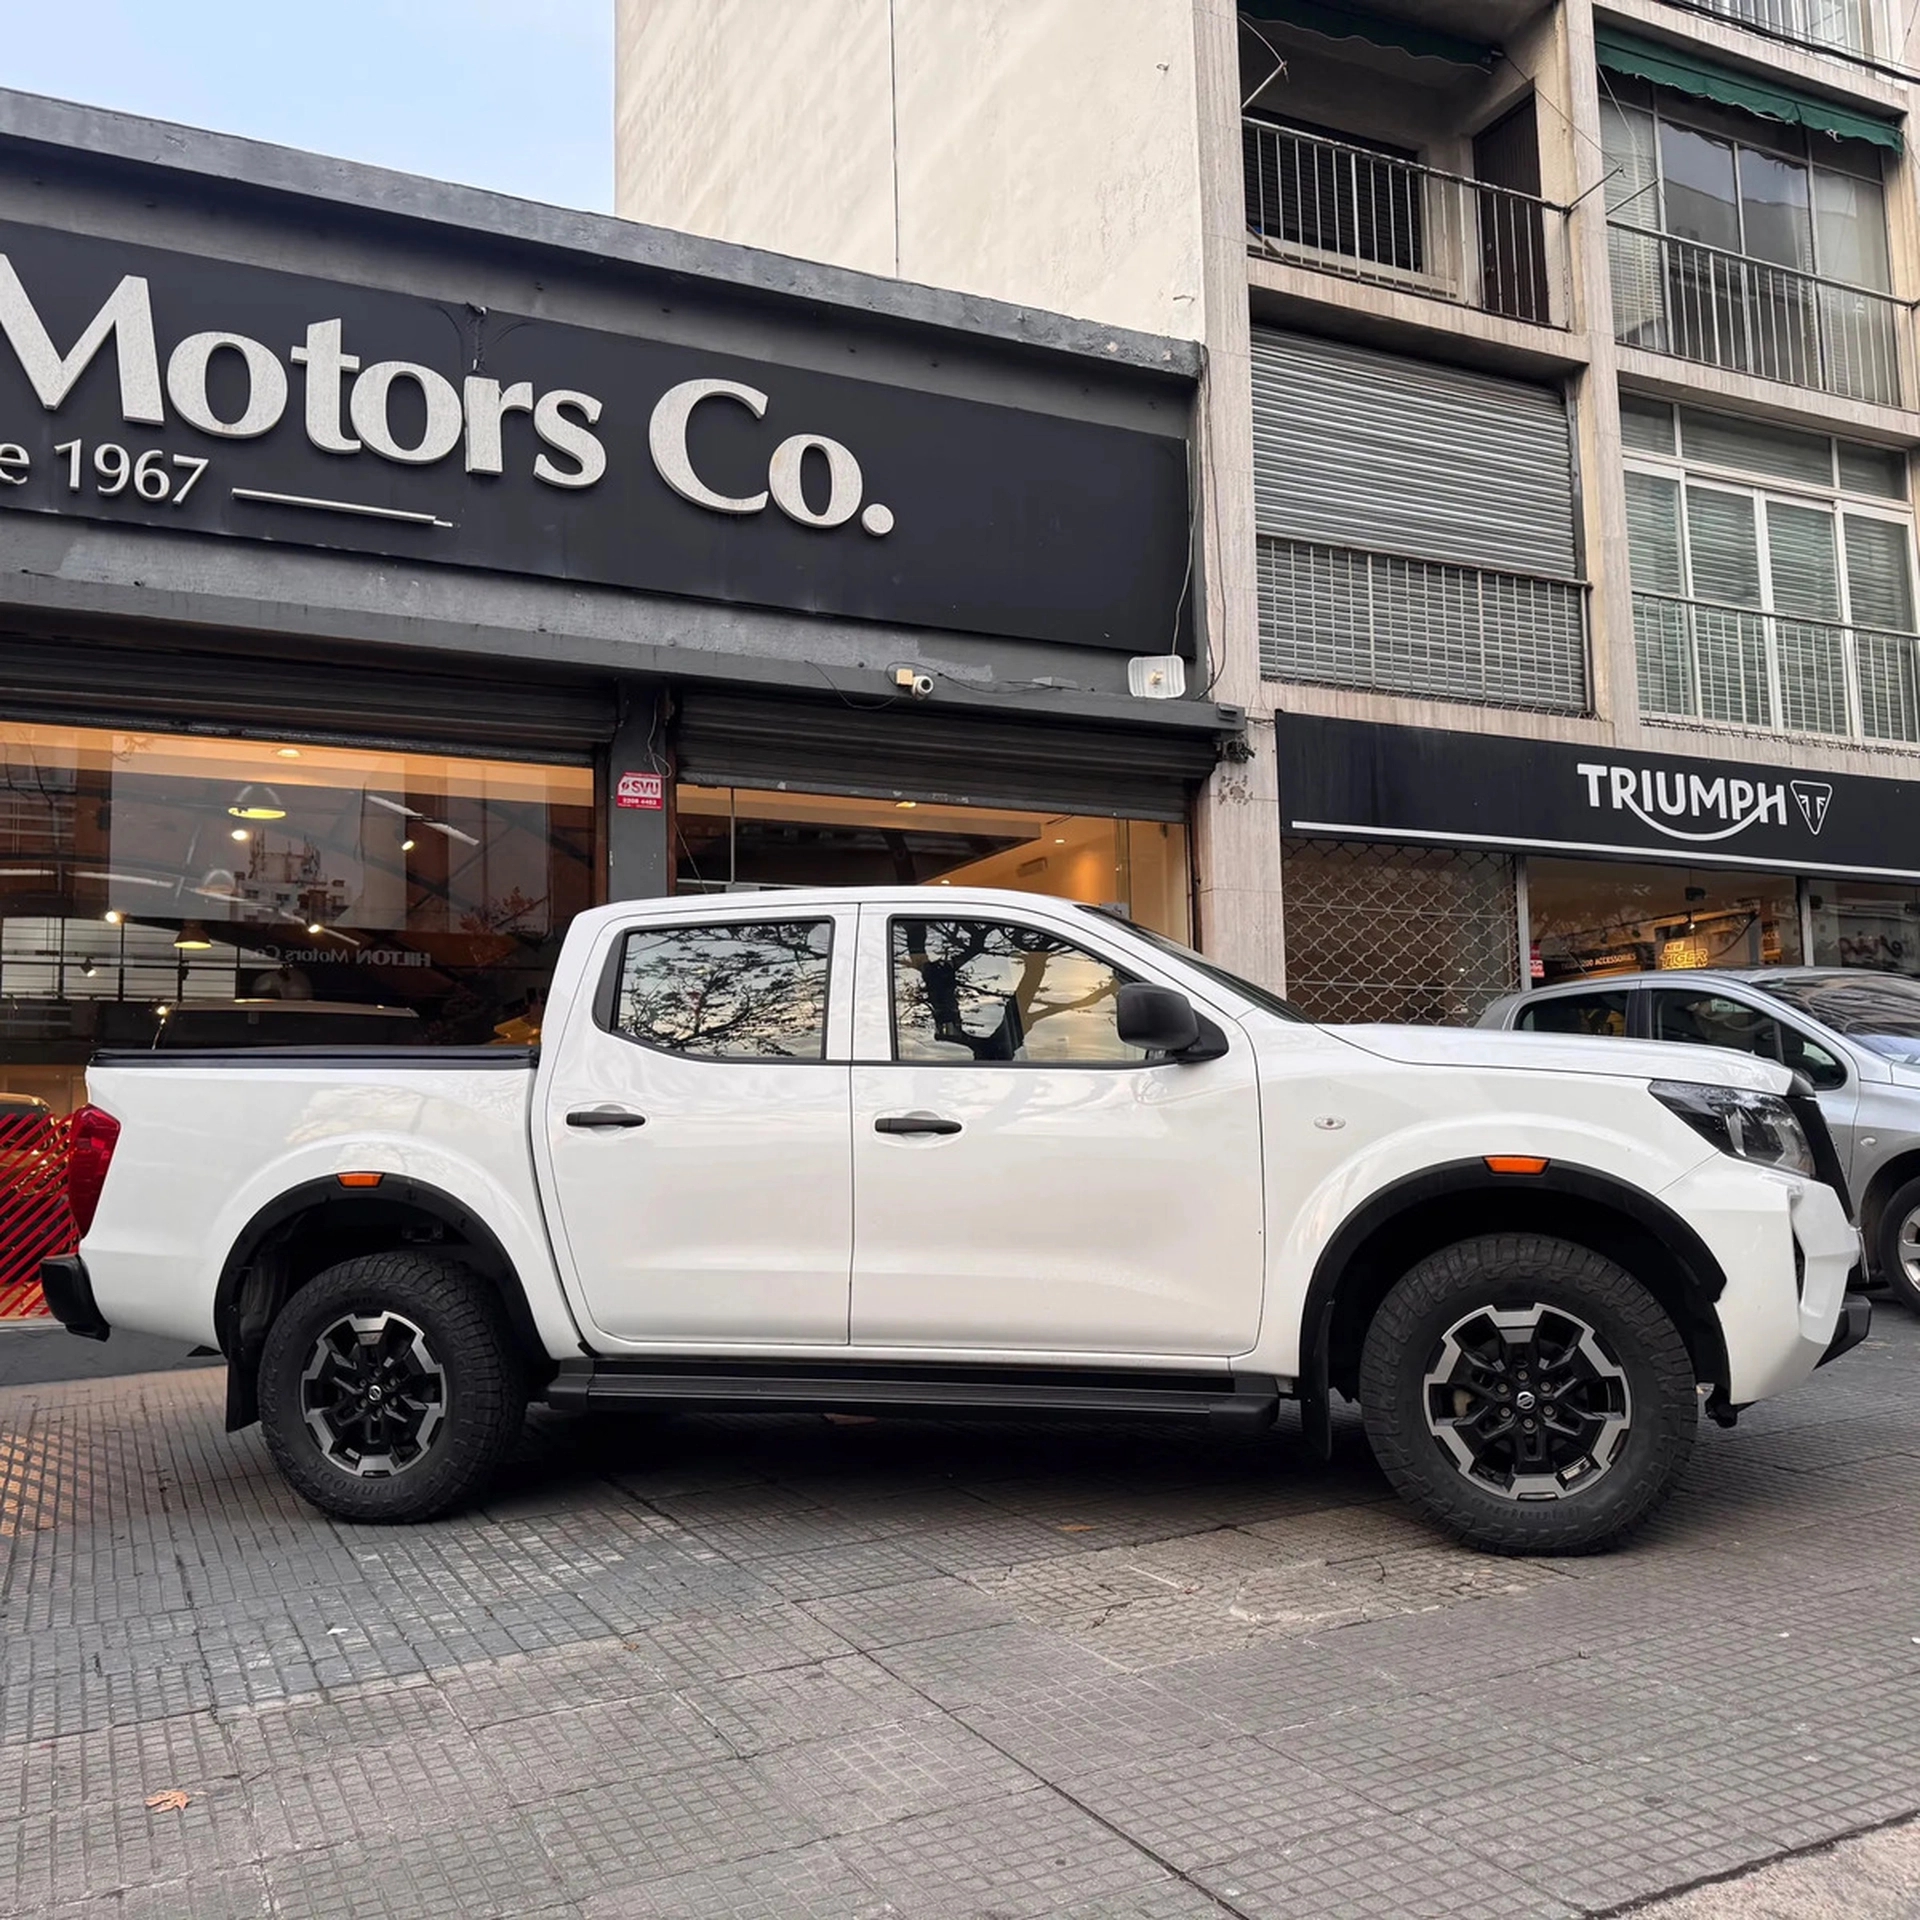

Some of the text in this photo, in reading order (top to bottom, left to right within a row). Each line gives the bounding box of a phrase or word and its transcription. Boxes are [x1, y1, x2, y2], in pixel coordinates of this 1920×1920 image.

[0, 253, 895, 537] Motors Co.
[54, 438, 209, 504] 1967
[631, 780, 659, 795] SVU
[1577, 763, 1787, 841] TRIUMPH
[1595, 952, 1636, 966] ACCESSORIES
[1660, 948, 1708, 967] TIGER
